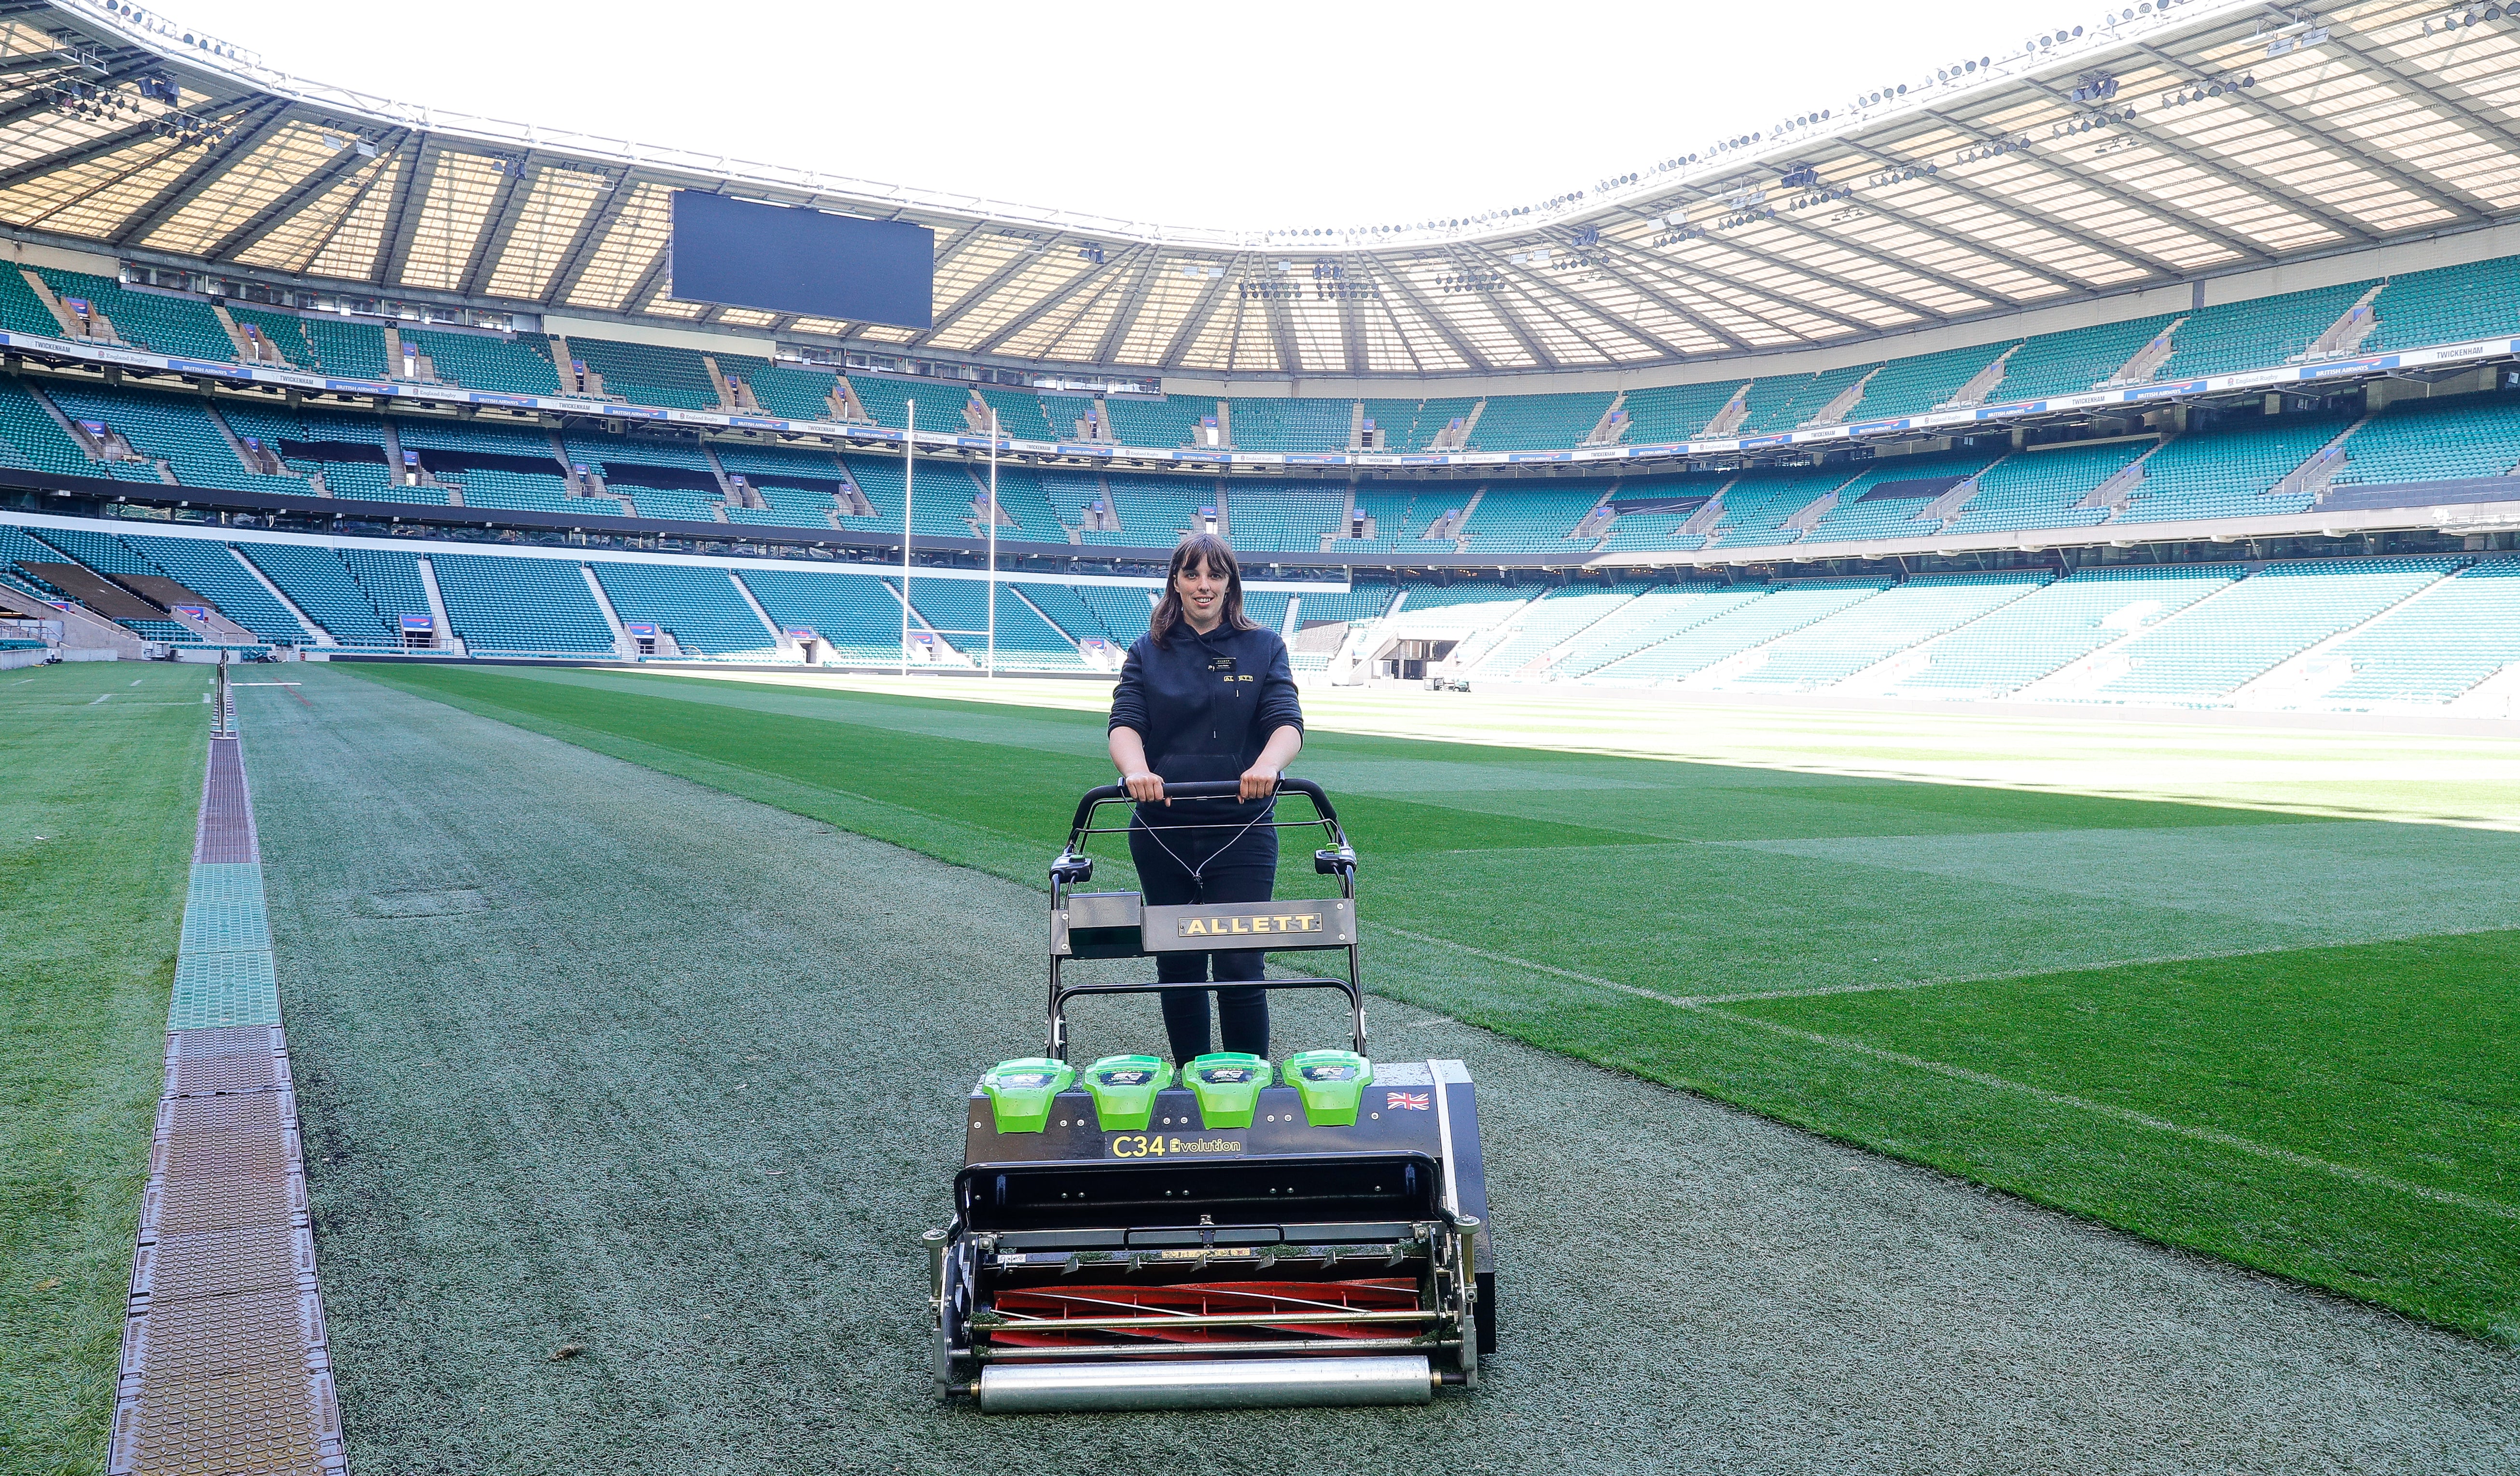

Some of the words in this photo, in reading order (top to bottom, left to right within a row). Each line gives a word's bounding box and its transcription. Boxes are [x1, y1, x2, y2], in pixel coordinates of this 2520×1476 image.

[35, 341, 70, 353] TWICKENHAM
[106, 353, 129, 361] England
[2436, 346, 2483, 359] TWICKENHAM
[2316, 367, 2340, 376] BRITISH
[2341, 365, 2368, 373] AIRWAYS
[279, 375, 314, 385] TWICKENHAM
[2260, 374, 2278, 383] Rugby
[2158, 388, 2181, 397] AIRWAYS
[2072, 396, 2105, 405] TWICKENHAM
[1186, 915, 1314, 934] ALLETT
[1113, 1136, 1165, 1158] C34
[1170, 1138, 1241, 1153] Evolution
